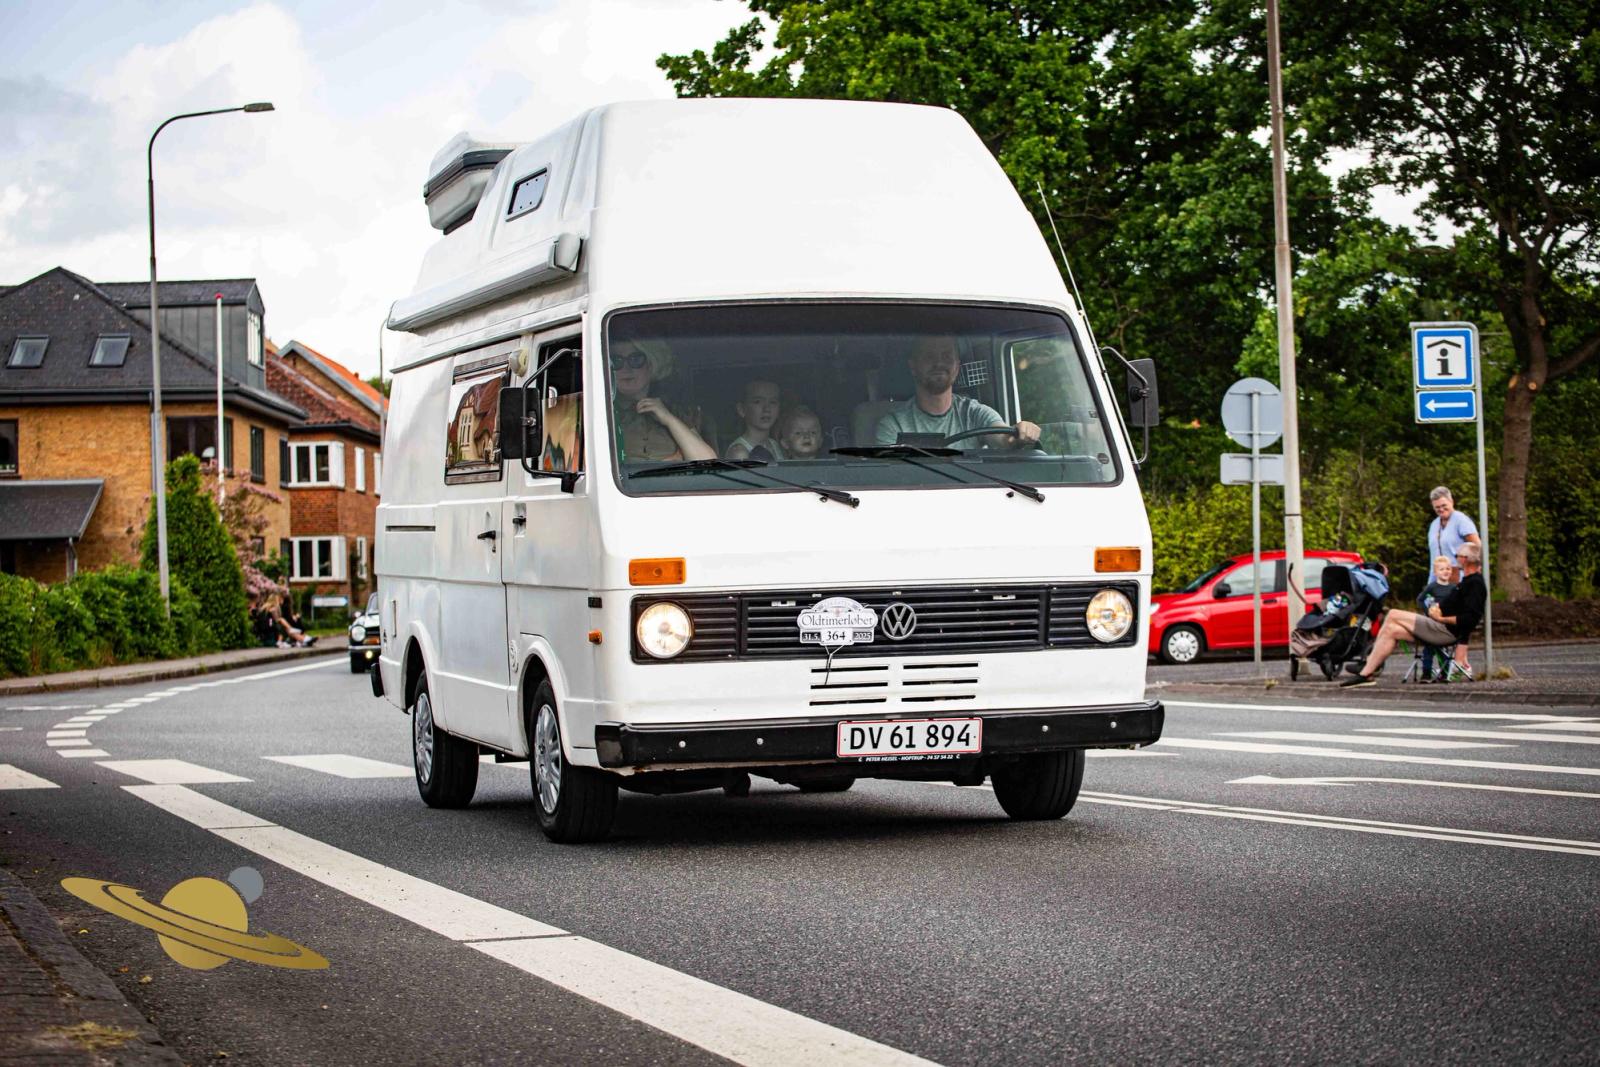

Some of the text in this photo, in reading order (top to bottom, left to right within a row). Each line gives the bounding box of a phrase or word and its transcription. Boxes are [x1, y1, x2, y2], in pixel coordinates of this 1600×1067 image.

[802, 614, 873, 626] Oldtimerløbet
[827, 630, 846, 641] 364
[854, 632, 871, 641] 2025
[850, 724, 970, 750] DV 61 894
